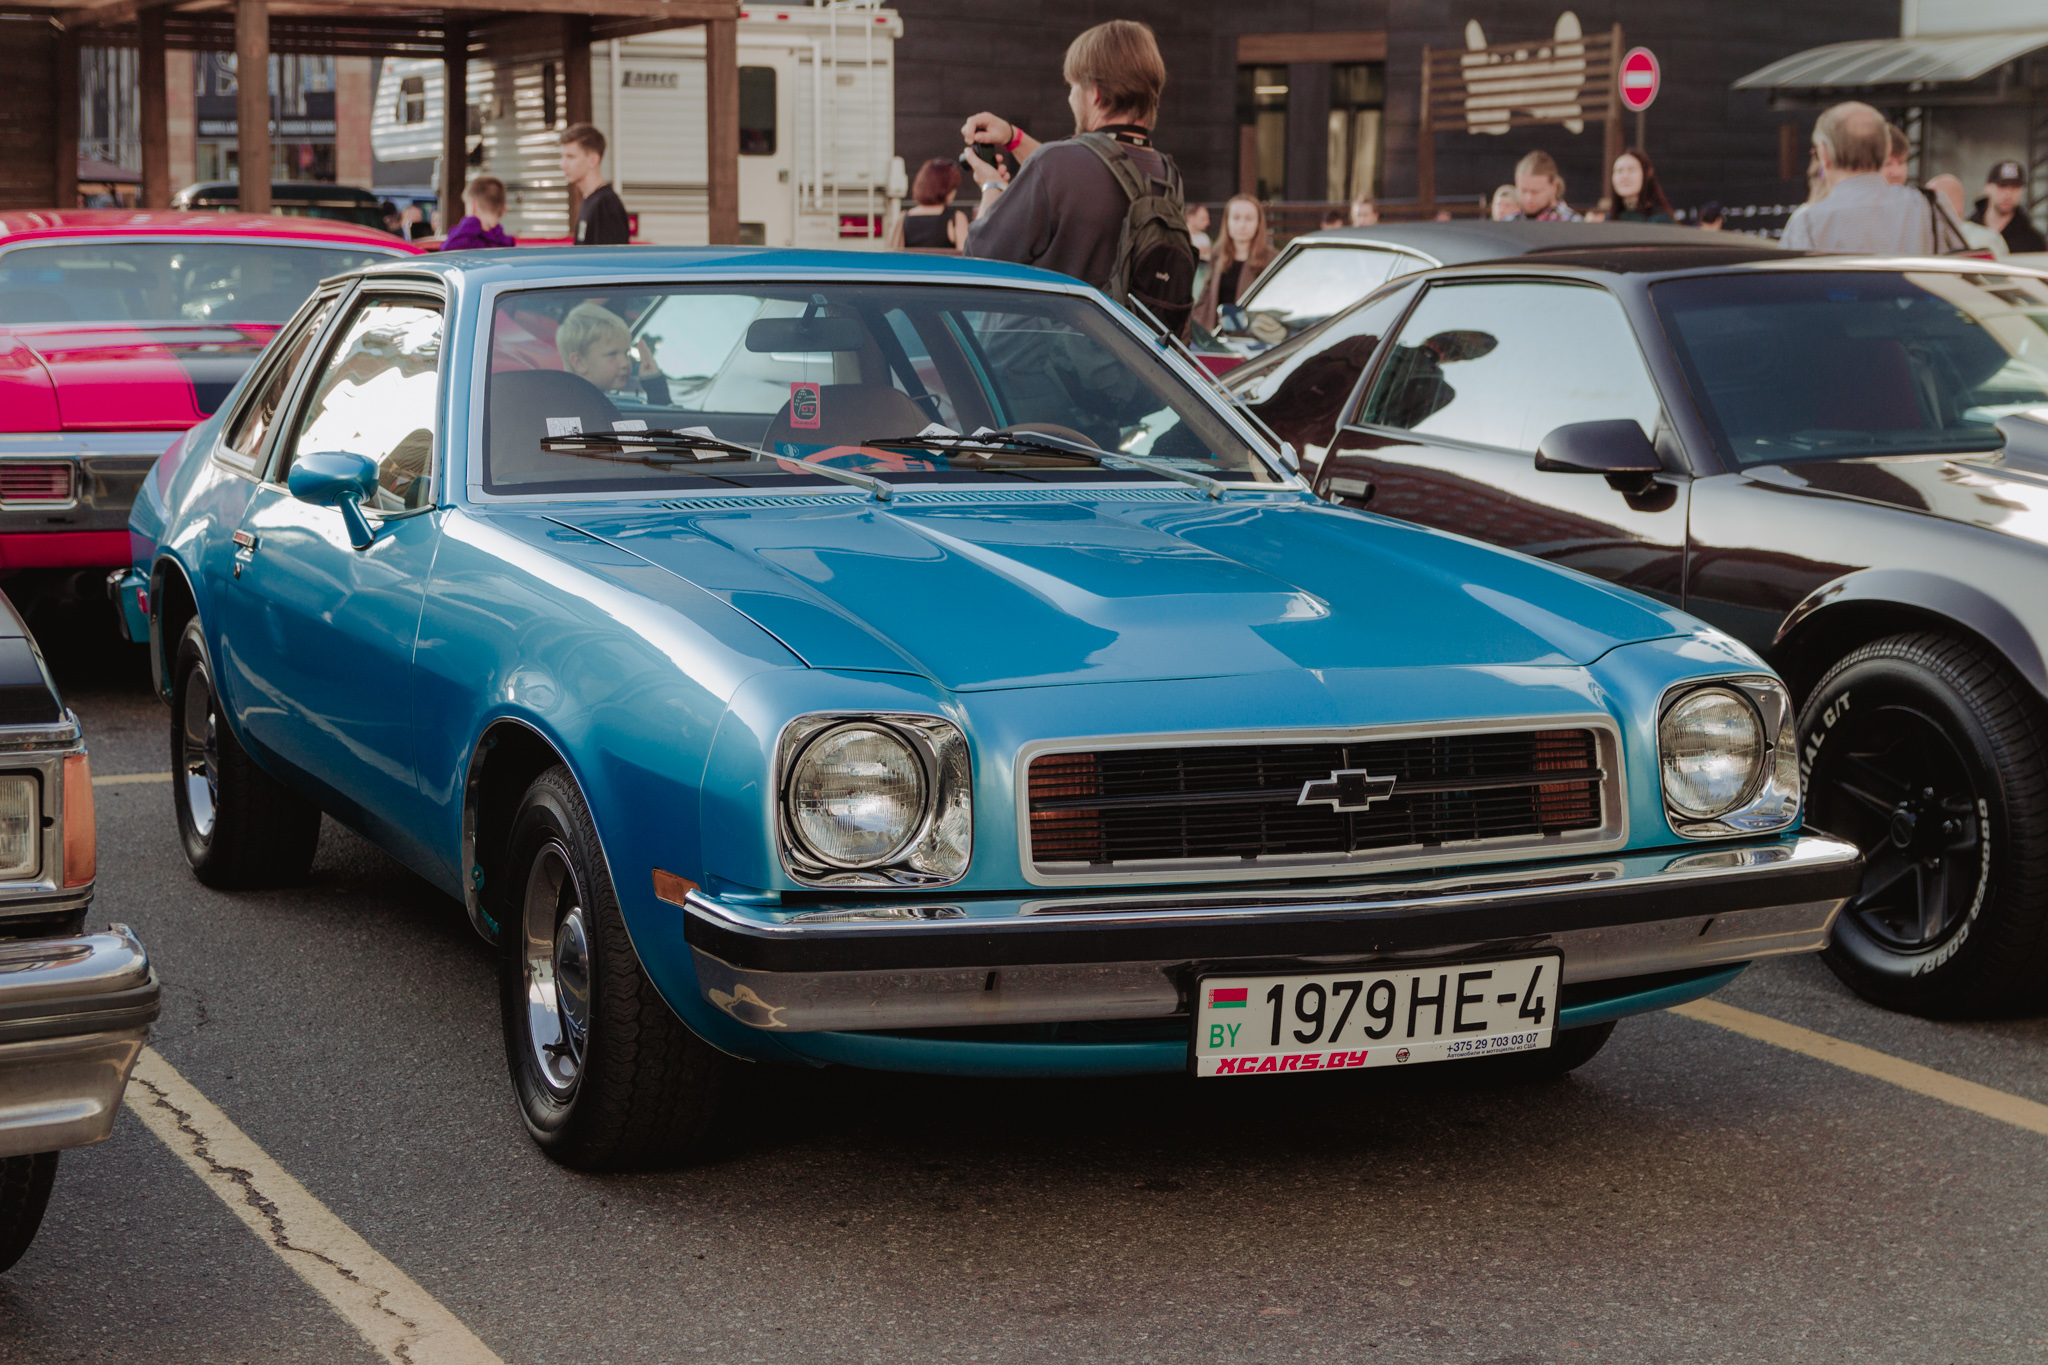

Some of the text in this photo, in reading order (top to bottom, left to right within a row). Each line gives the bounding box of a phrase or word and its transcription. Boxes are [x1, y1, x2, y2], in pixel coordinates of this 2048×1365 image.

[1801, 691, 1850, 823] DIAL G/T
[1911, 798, 1990, 978] COOPER COBRA
[1209, 1023, 1242, 1048] BY
[1447, 1033, 1538, 1052] +375 29 703 03 07
[1215, 1051, 1369, 1074] XCARS.BY
[1447, 1050, 1480, 1058] Автомобили
